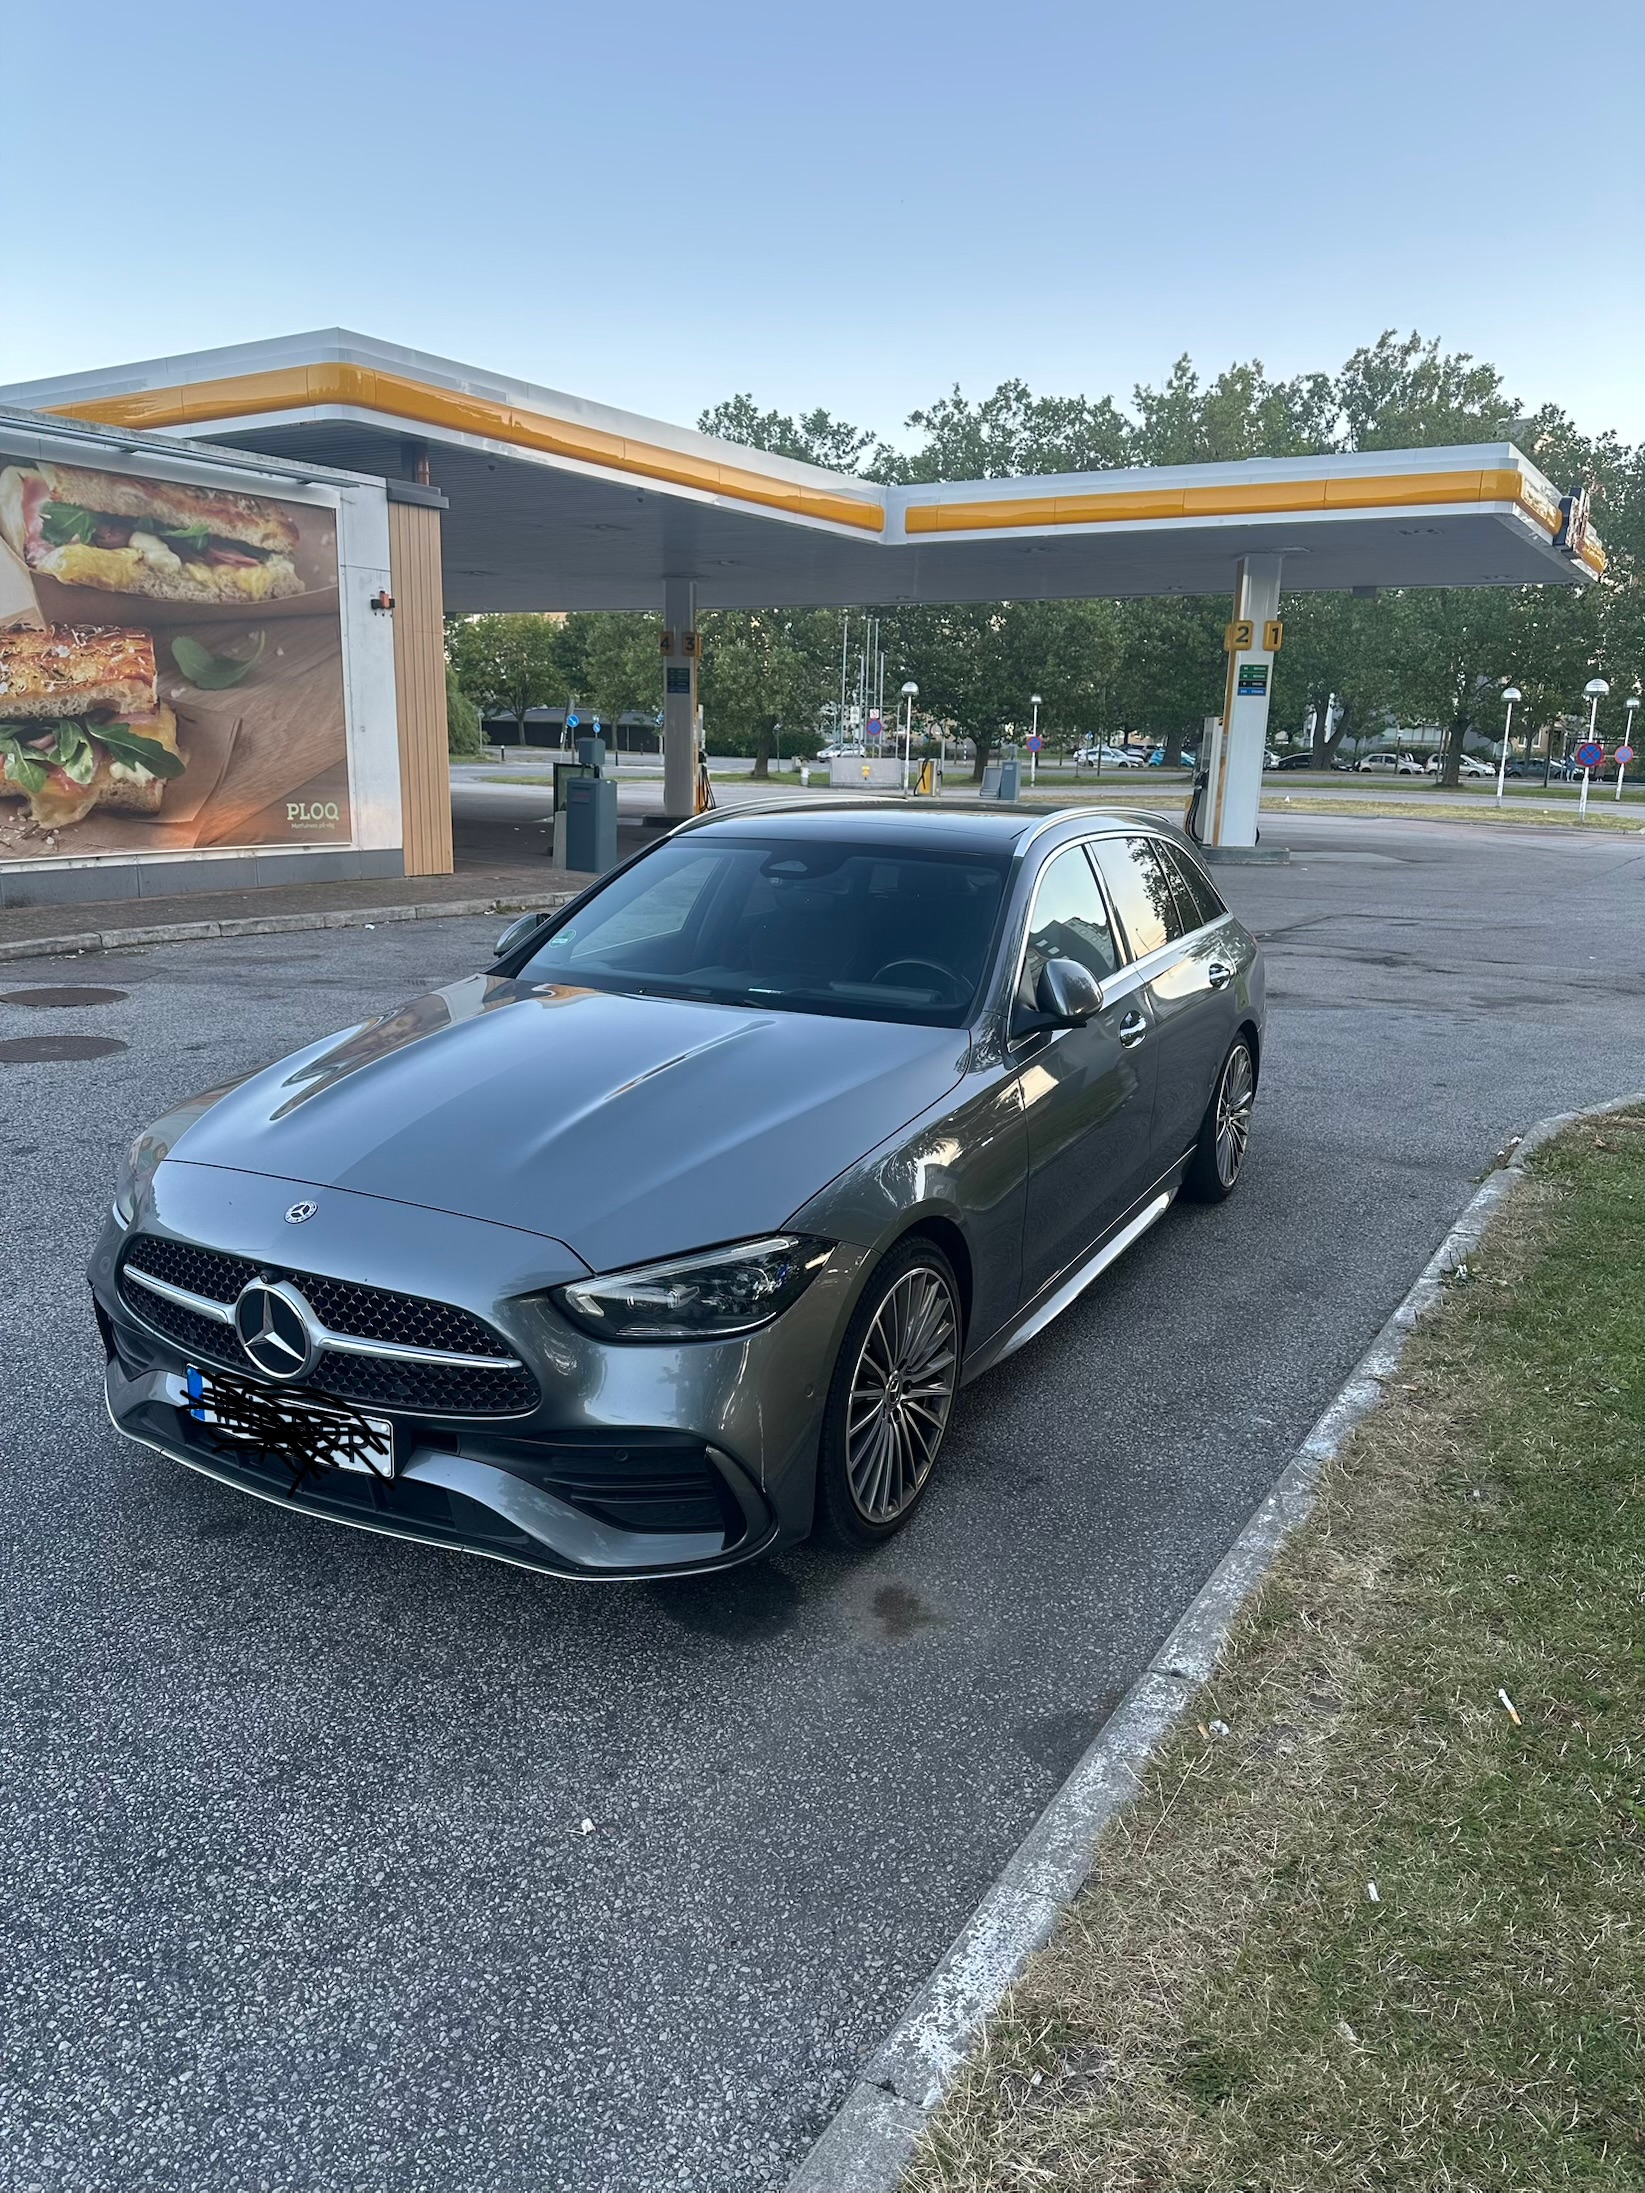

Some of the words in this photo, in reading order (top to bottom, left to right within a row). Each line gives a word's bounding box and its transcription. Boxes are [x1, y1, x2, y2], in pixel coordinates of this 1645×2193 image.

[660, 636, 670, 650] 4
[1235, 626, 1249, 643] 2
[1271, 627, 1279, 645] 1
[685, 636, 695, 651] 3
[286, 802, 339, 820] PLOQ
